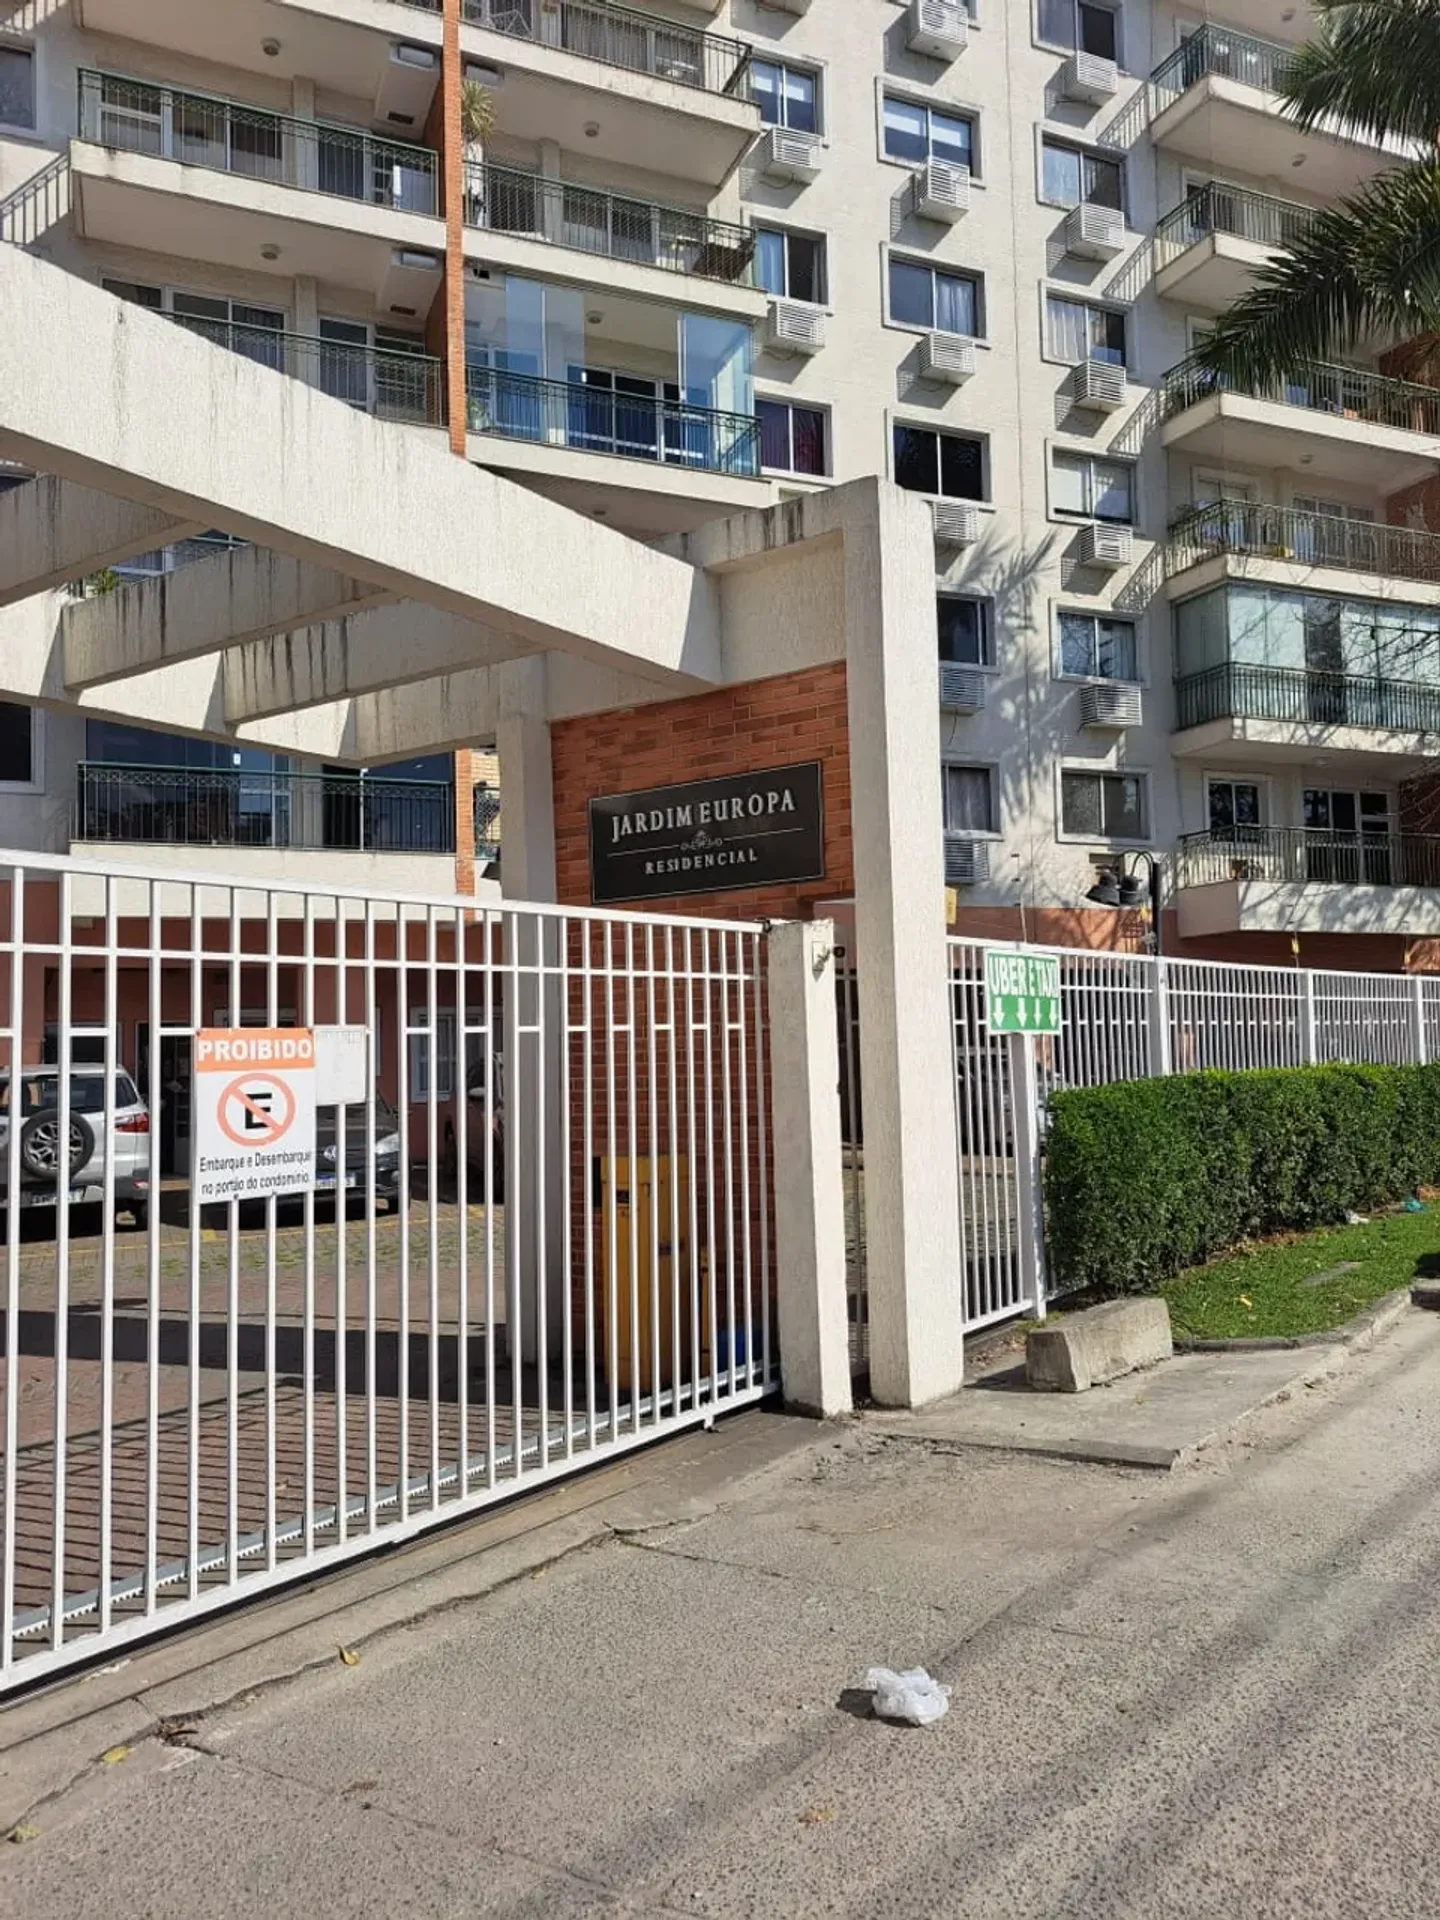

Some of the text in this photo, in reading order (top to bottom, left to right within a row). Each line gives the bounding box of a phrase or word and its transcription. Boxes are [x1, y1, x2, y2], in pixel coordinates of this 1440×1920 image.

[612, 789, 795, 842] JARDIM EUROPA
[645, 849, 758, 875] RESIDENCIAL
[988, 957, 1027, 996] UBER
[1029, 959, 1036, 996] E
[198, 1039, 312, 1062] PROIBIDO
[200, 1151, 312, 1173] Embarque e Desembarque
[201, 1182, 213, 1195] no
[215, 1176, 244, 1197] portão
[246, 1176, 258, 1190] do
